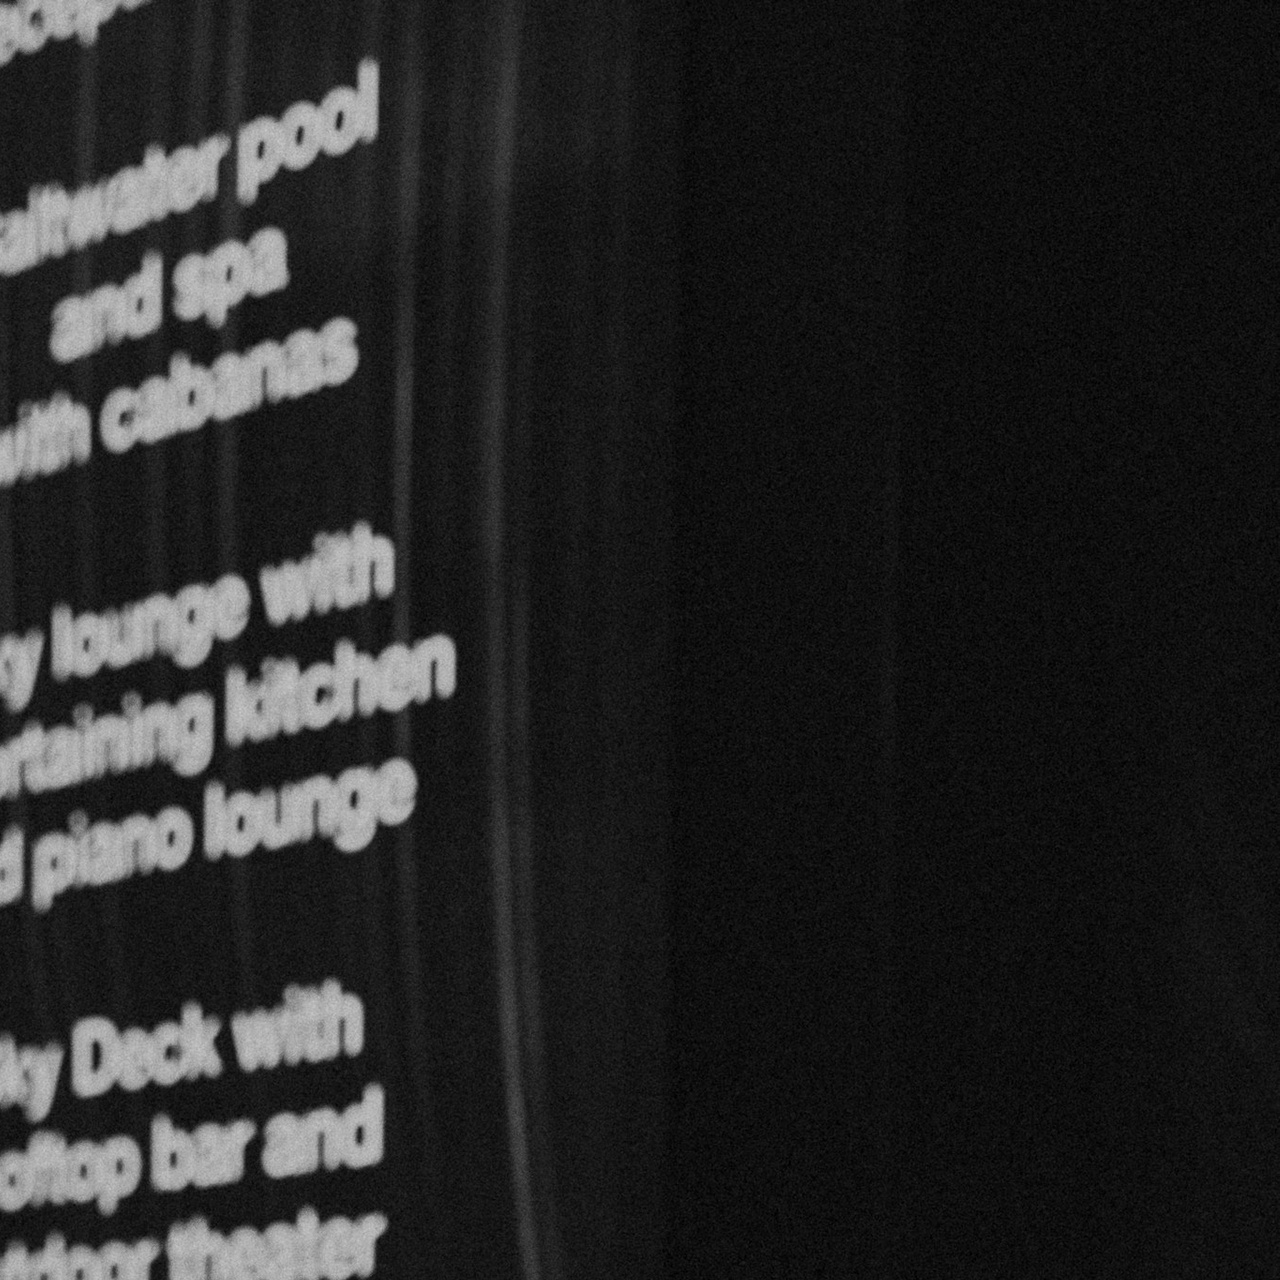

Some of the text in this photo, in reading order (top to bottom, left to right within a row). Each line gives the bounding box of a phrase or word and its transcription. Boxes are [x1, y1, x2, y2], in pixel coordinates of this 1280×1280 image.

[235, 57, 380, 205] pool
[49, 227, 290, 363] and spa
[99, 317, 360, 453] cabanas
[51, 573, 251, 680] lounge
[259, 520, 396, 627] with
[225, 633, 457, 748] kitchen
[31, 806, 194, 912] piano
[203, 757, 418, 861] lounge
[71, 1001, 223, 1098] Deck
[230, 978, 366, 1073] with
[150, 1113, 256, 1191] bar
[261, 1083, 385, 1179] and
